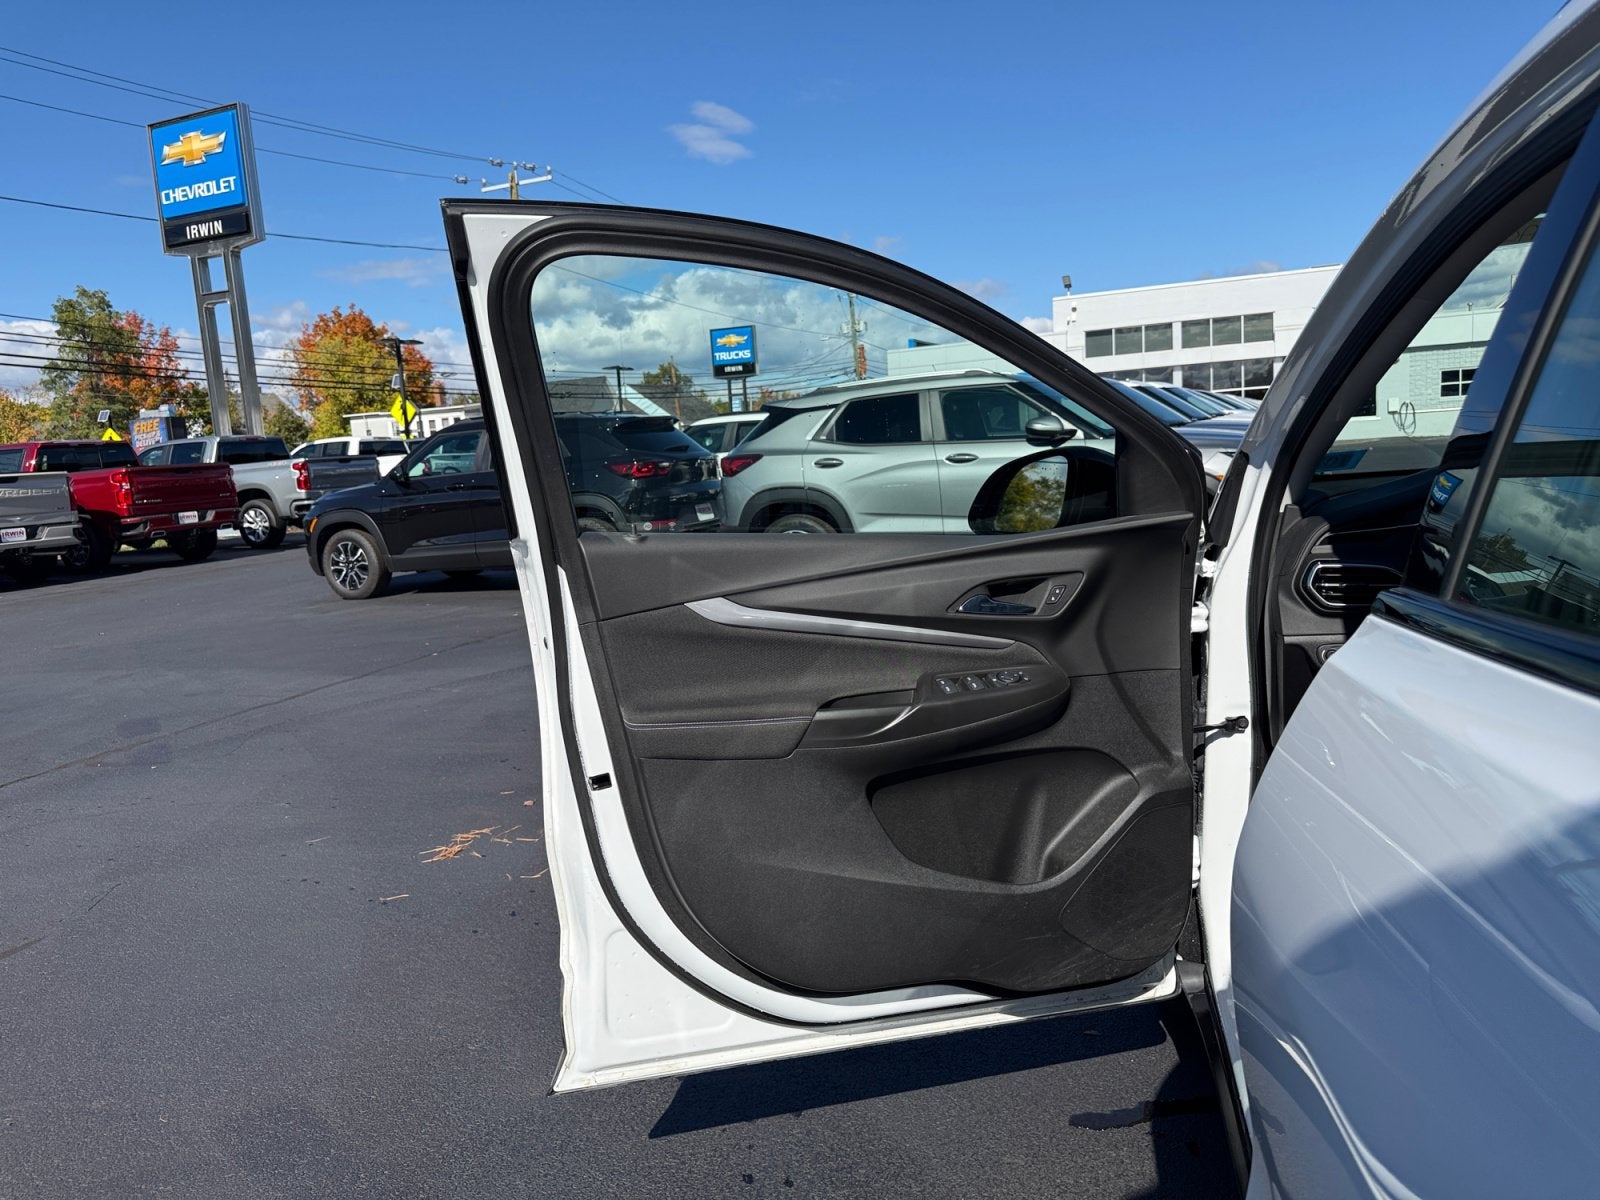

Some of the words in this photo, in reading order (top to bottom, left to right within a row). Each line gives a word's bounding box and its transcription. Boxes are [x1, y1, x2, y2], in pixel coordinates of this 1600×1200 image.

[161, 176, 236, 205] CHEVROLET
[186, 219, 223, 239] IRWIN
[714, 349, 751, 361] TRUCKS
